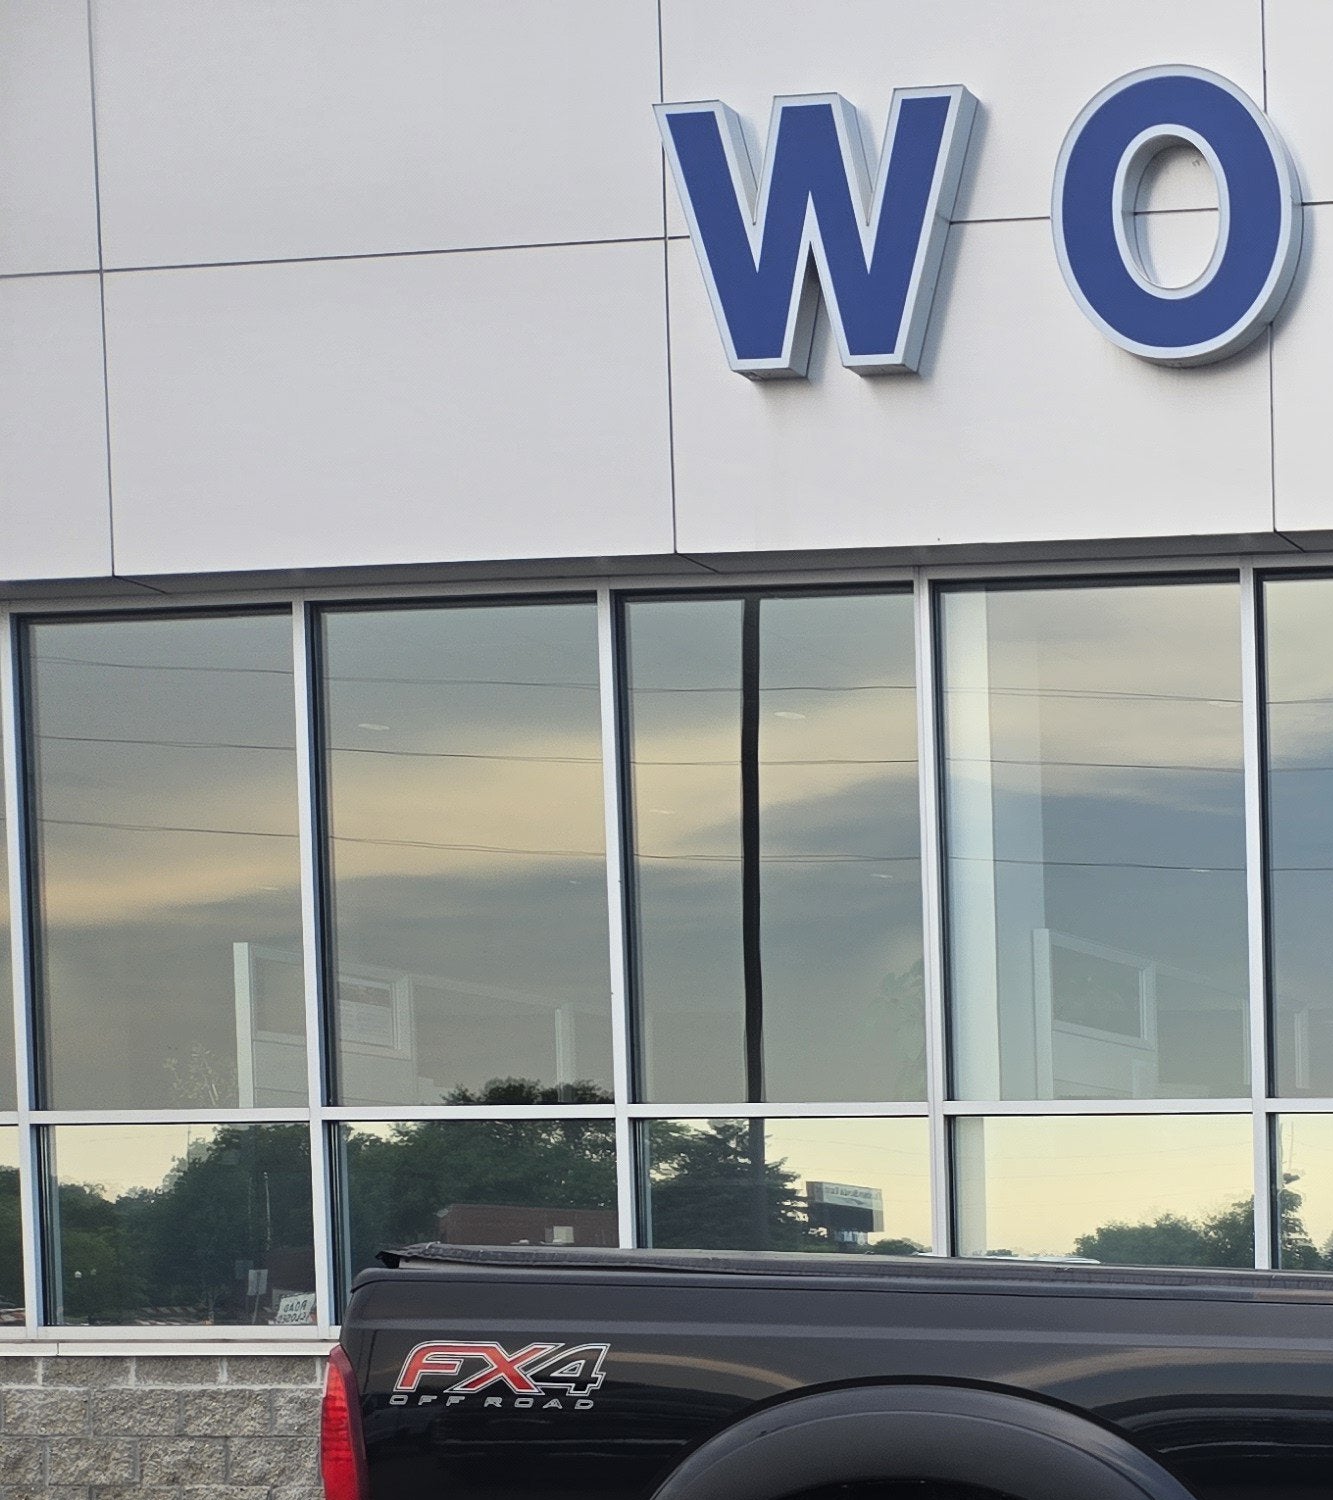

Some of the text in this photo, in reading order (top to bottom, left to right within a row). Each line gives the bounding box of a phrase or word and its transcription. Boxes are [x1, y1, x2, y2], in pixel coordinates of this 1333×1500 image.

[394, 1340, 611, 1397] FX4
[389, 1394, 595, 1410] OFF ROAD
